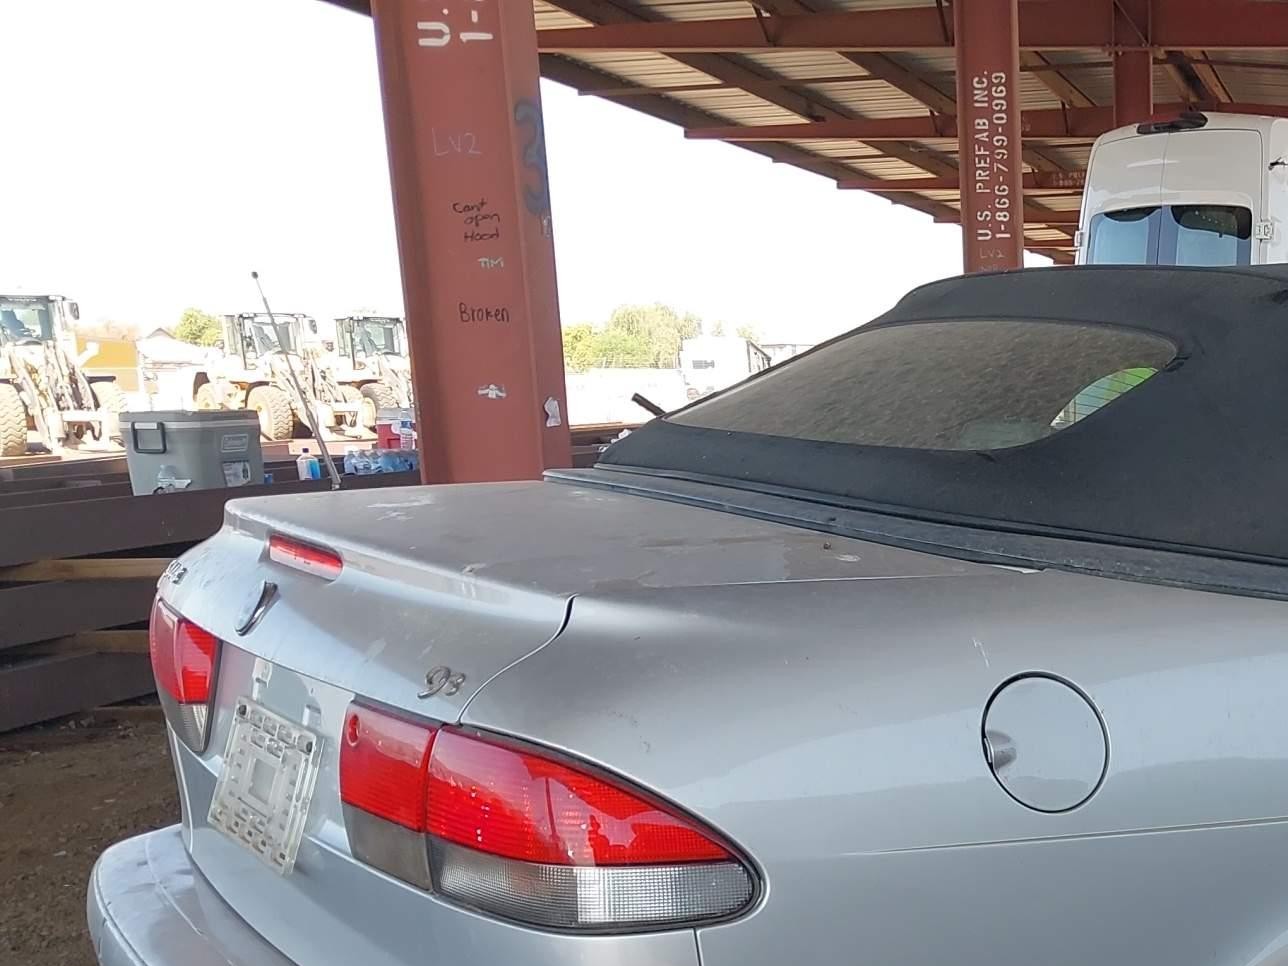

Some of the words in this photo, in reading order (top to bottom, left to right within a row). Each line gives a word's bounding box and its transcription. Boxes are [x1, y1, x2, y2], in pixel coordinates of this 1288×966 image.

[972, 70, 989, 108] INC.
[974, 118, 991, 193] PREFAB
[991, 72, 1011, 239] 1-866-799-0969
[463, 212, 501, 227] open
[976, 204, 992, 241] U.S.
[458, 301, 510, 323] Broken
